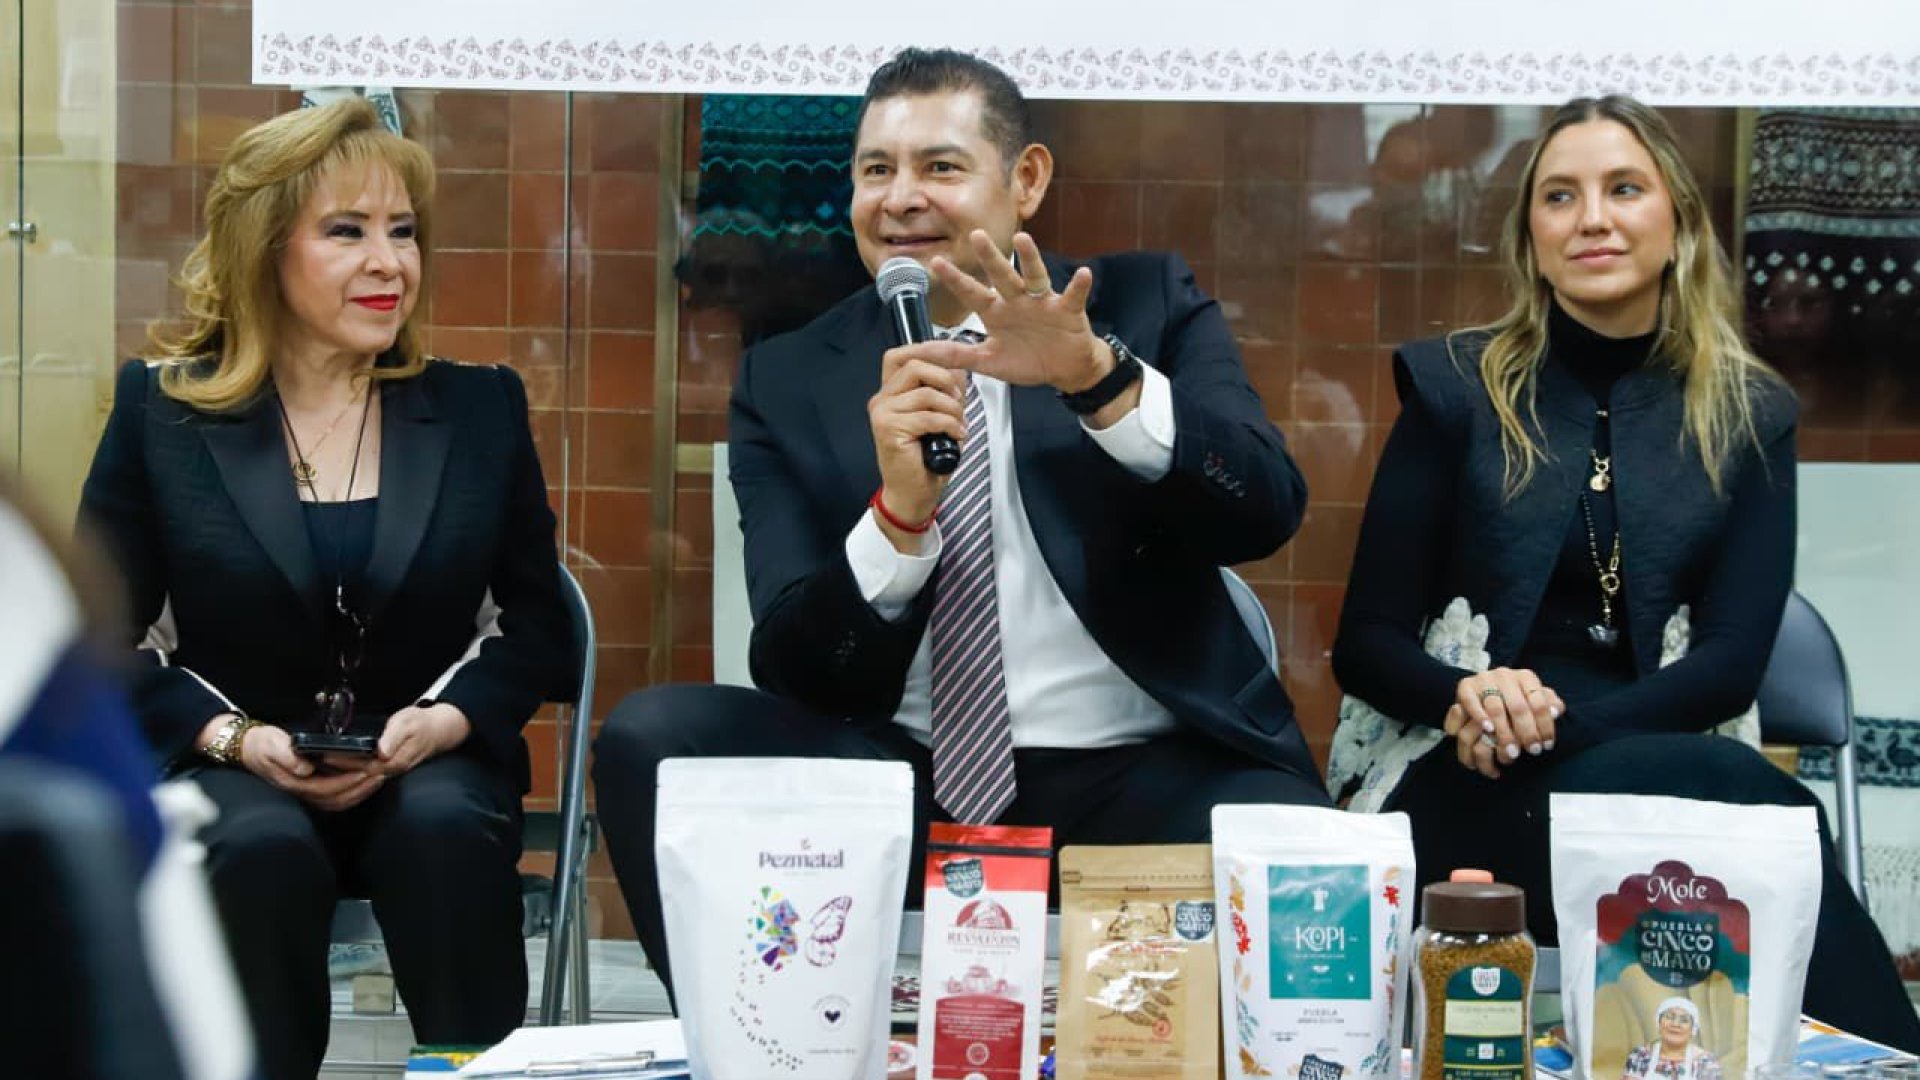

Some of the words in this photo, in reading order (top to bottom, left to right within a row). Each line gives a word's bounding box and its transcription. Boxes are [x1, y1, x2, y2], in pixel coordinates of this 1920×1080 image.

[1646, 875, 1708, 905] Mole
[1650, 920, 1702, 931] PUEBLA
[1295, 925, 1345, 951] KOPI
[1641, 930, 1714, 951] CINCO
[1652, 949, 1711, 970] MAYO
